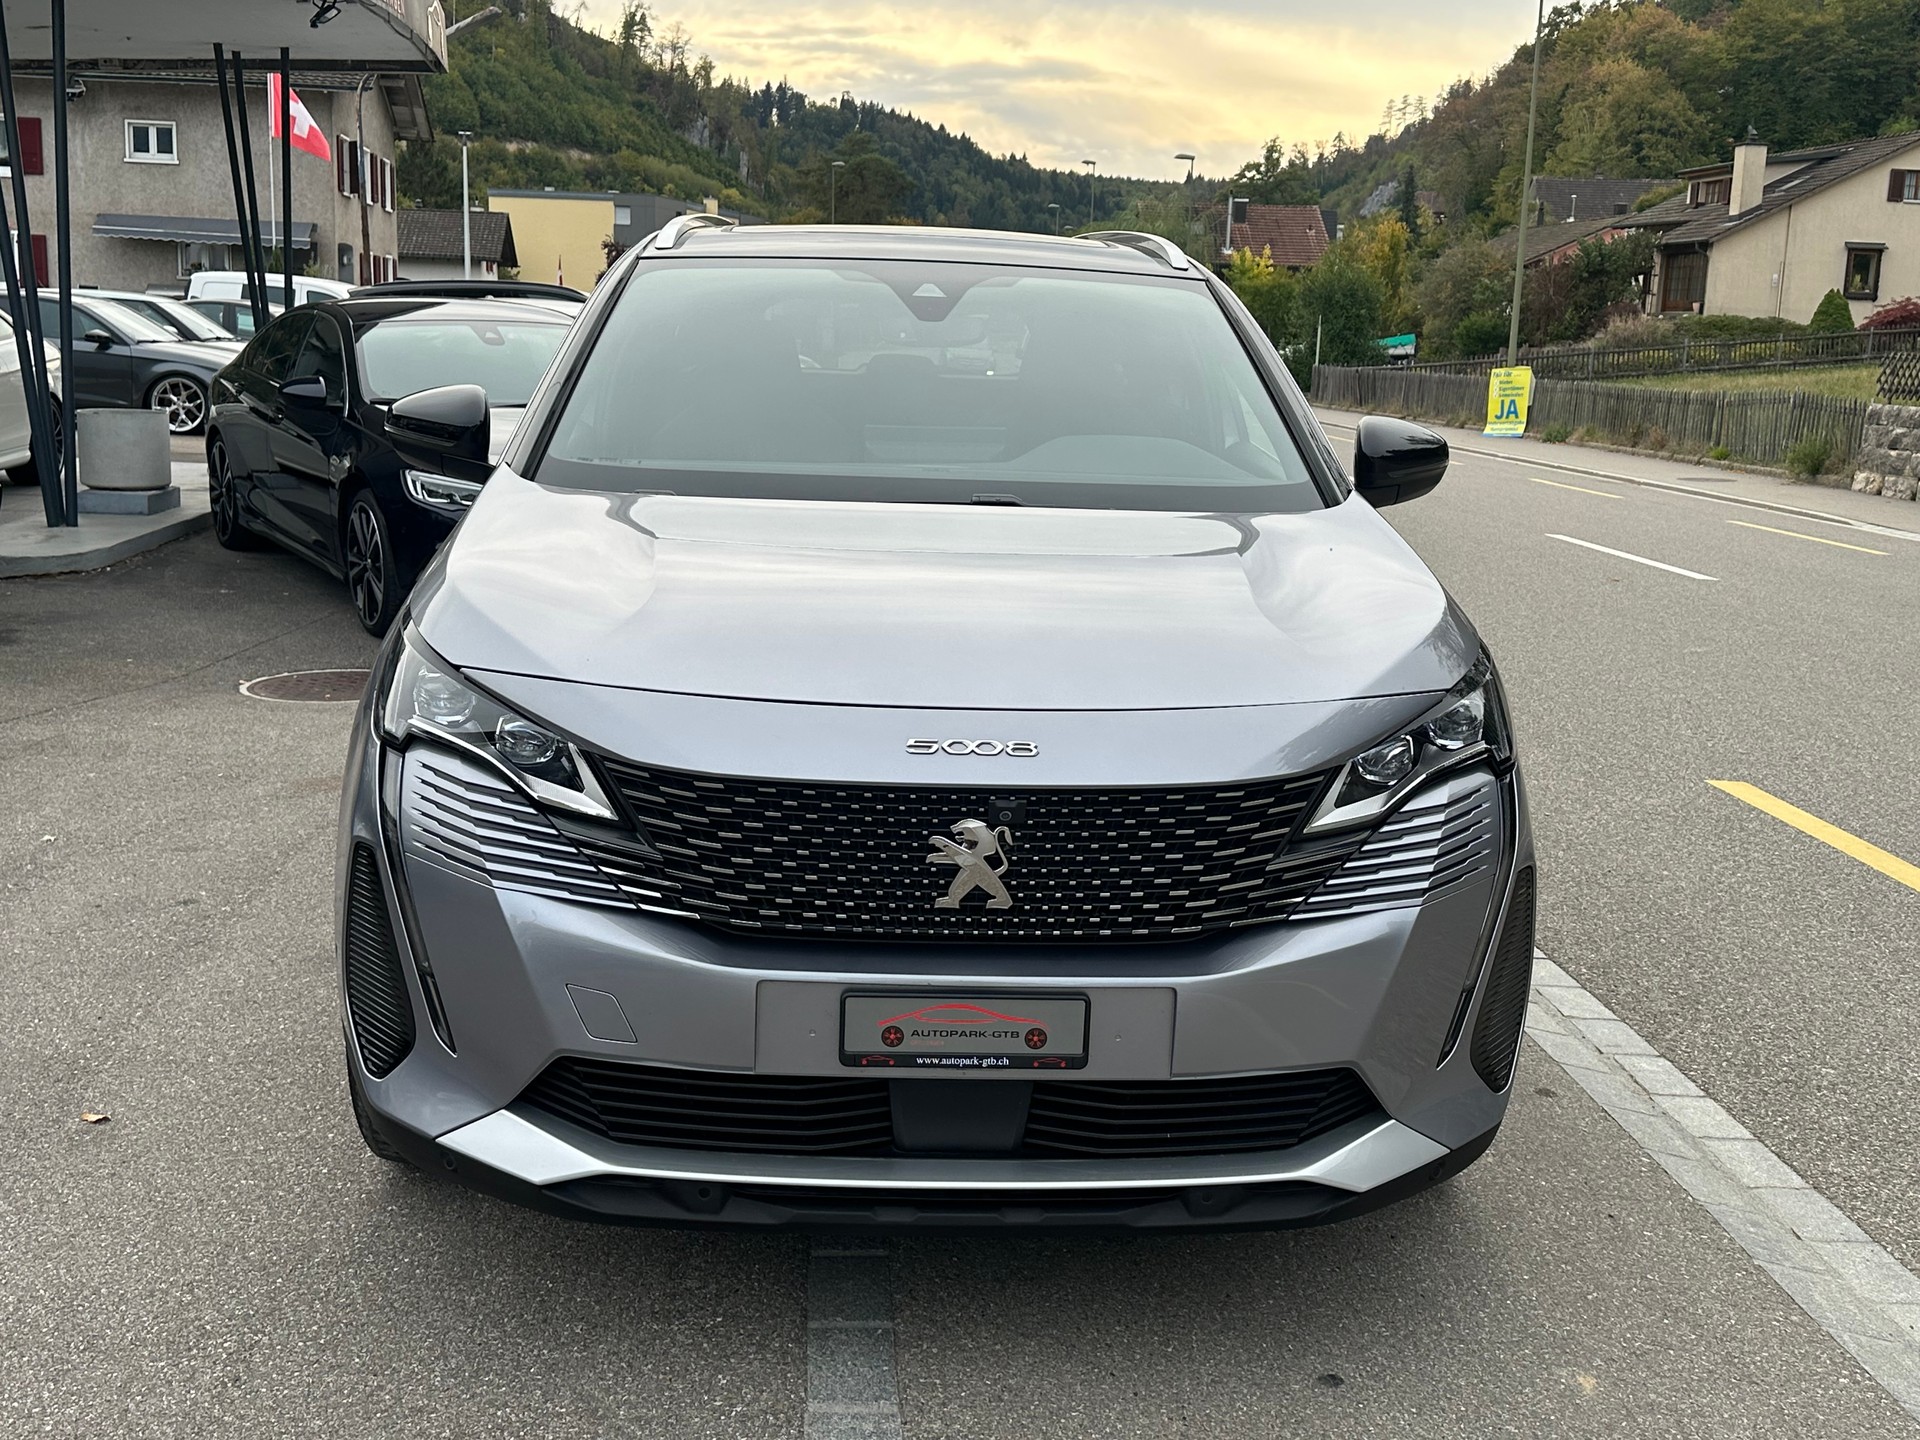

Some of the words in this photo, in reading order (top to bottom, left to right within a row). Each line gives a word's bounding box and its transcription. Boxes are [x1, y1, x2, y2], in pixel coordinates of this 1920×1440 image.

[1494, 399, 1520, 420] JA
[905, 738, 1039, 757] 5008
[910, 1029, 1020, 1039] AUTOPARK-GTB
[916, 1056, 1010, 1068] www.autopark-gtb.ch
